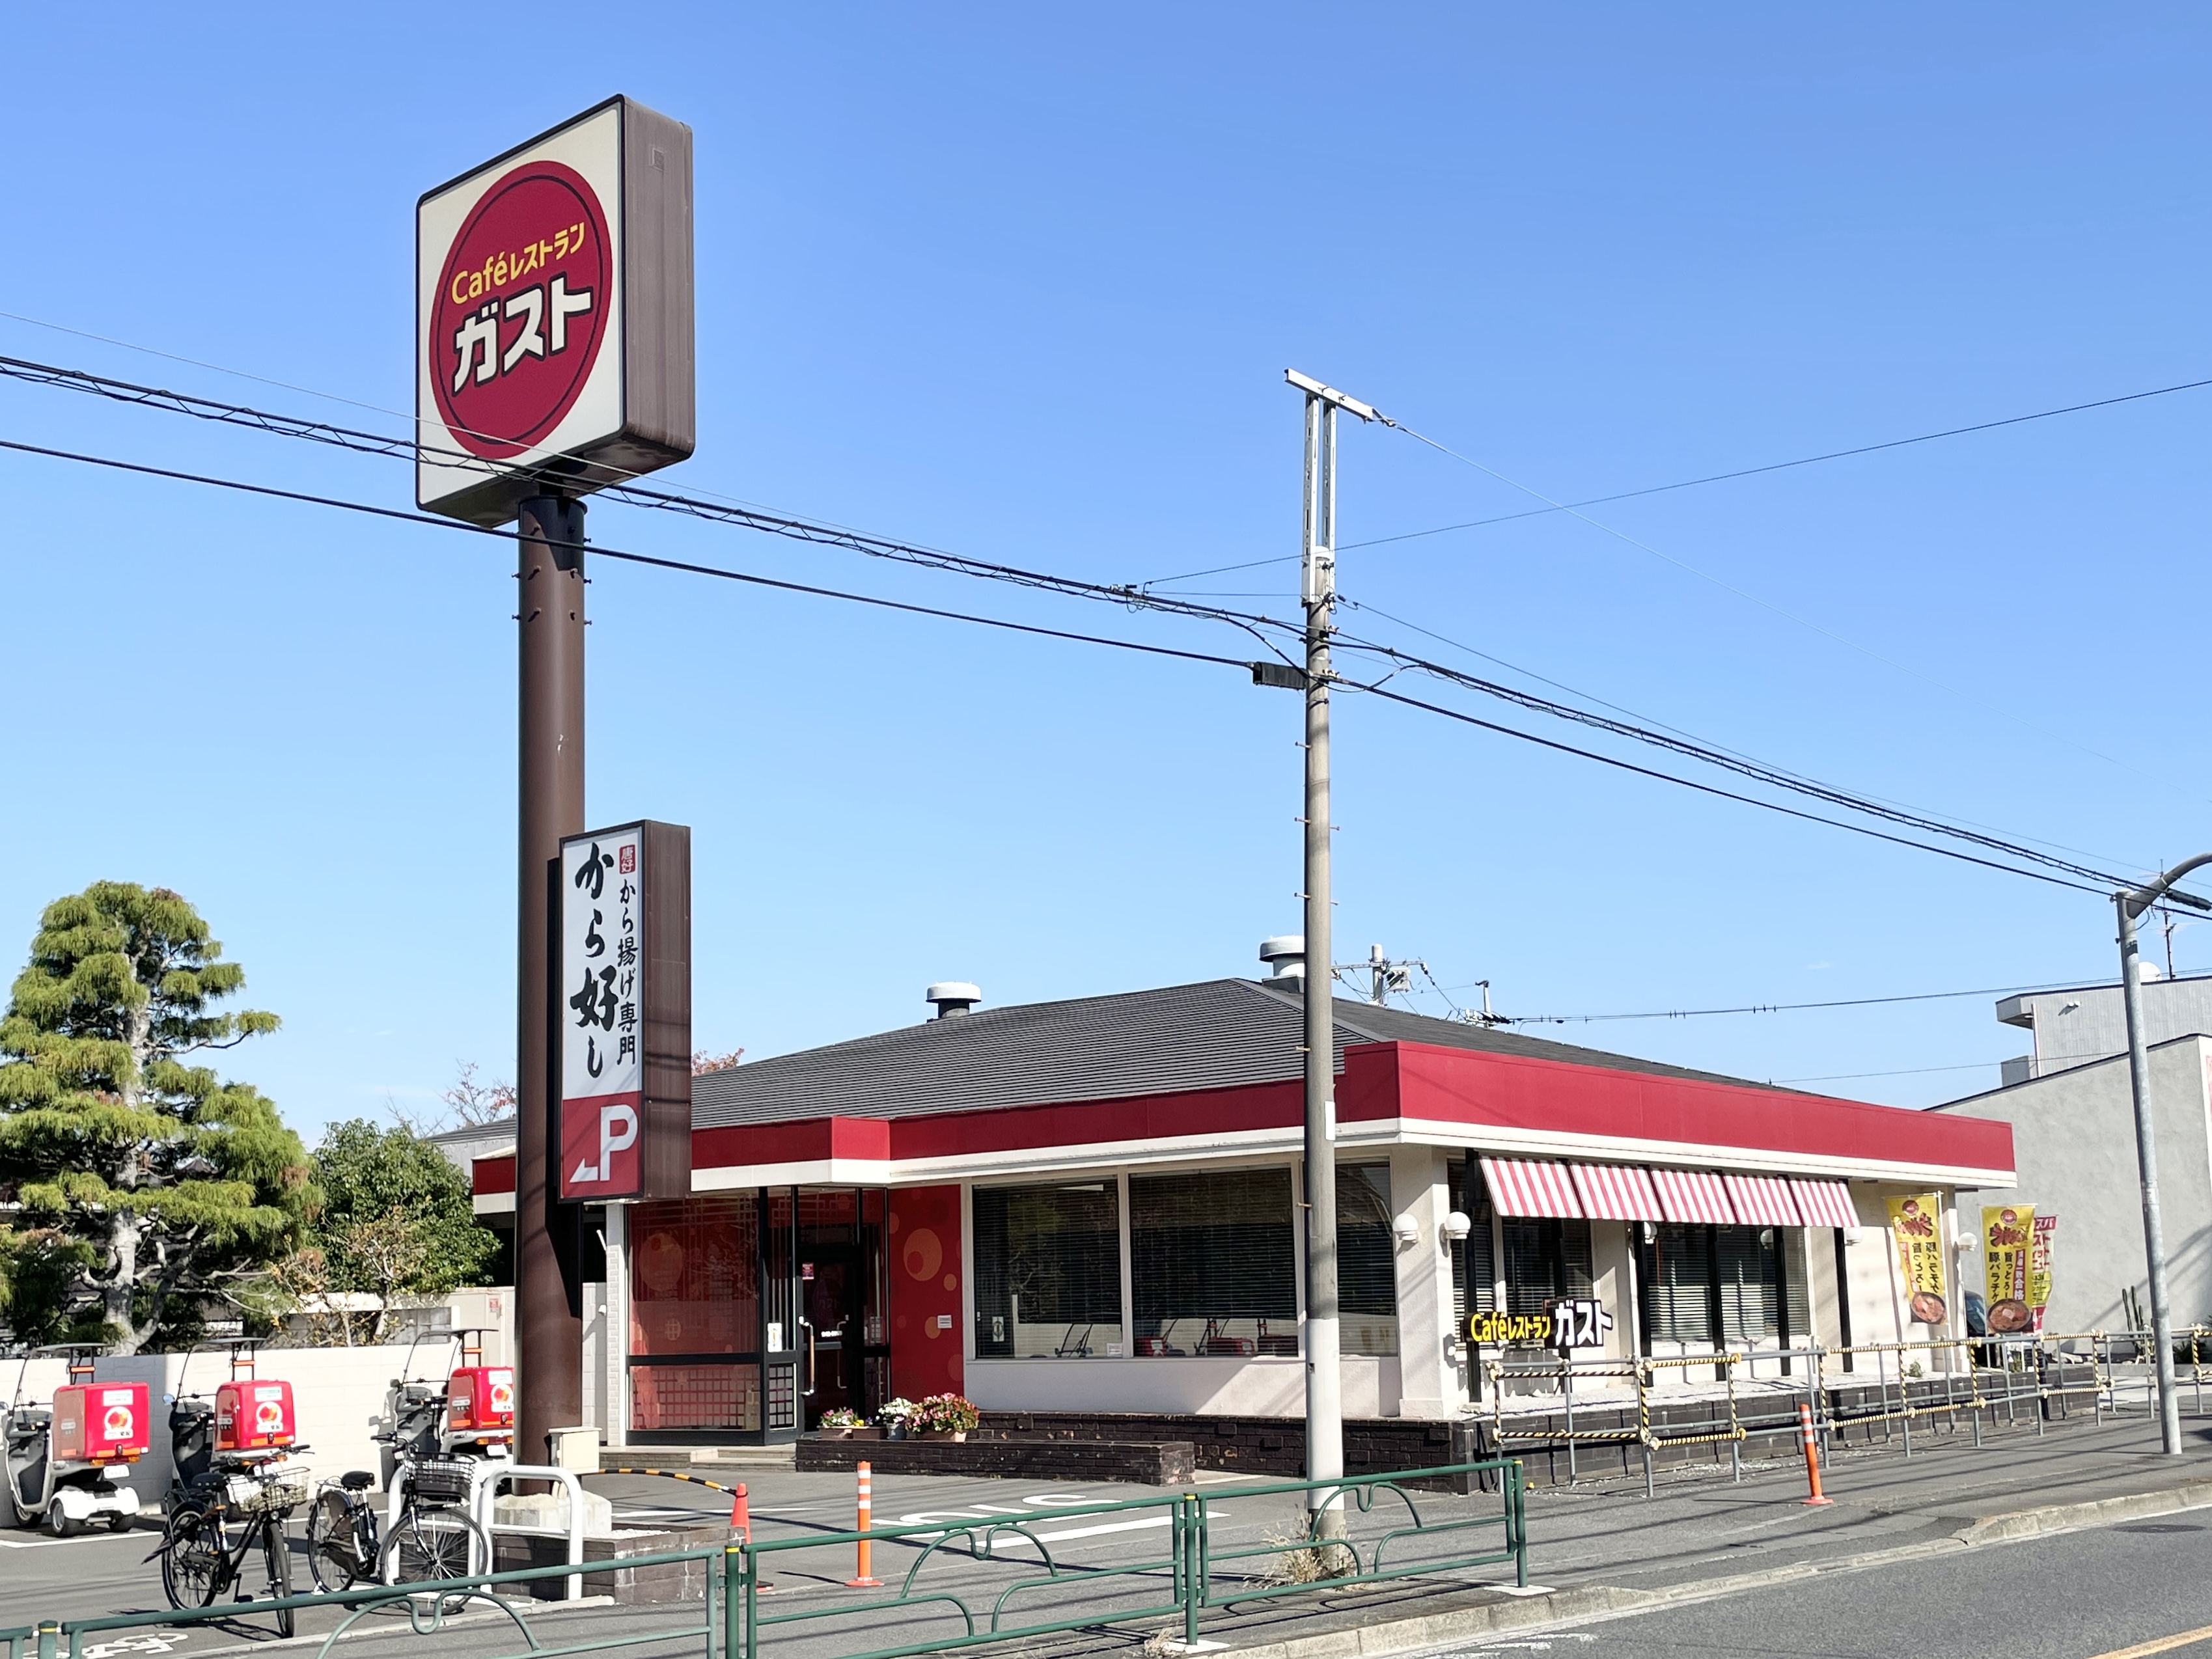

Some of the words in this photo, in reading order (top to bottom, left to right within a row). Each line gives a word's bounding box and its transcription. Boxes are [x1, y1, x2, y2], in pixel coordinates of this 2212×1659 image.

[452, 223, 585, 304] Caféレストラン
[453, 275, 592, 394] ガスト
[570, 842, 618, 1078] から好し
[617, 879, 639, 1066] から揚げ専門
[600, 1104, 639, 1181] P
[2032, 1233, 2051, 1246] スト
[2036, 1218, 2055, 1229] スパ
[2032, 1259, 2050, 1270] ニュー
[1471, 1311, 1551, 1342] Caféレストラン
[1555, 1300, 1612, 1346] ガスト
